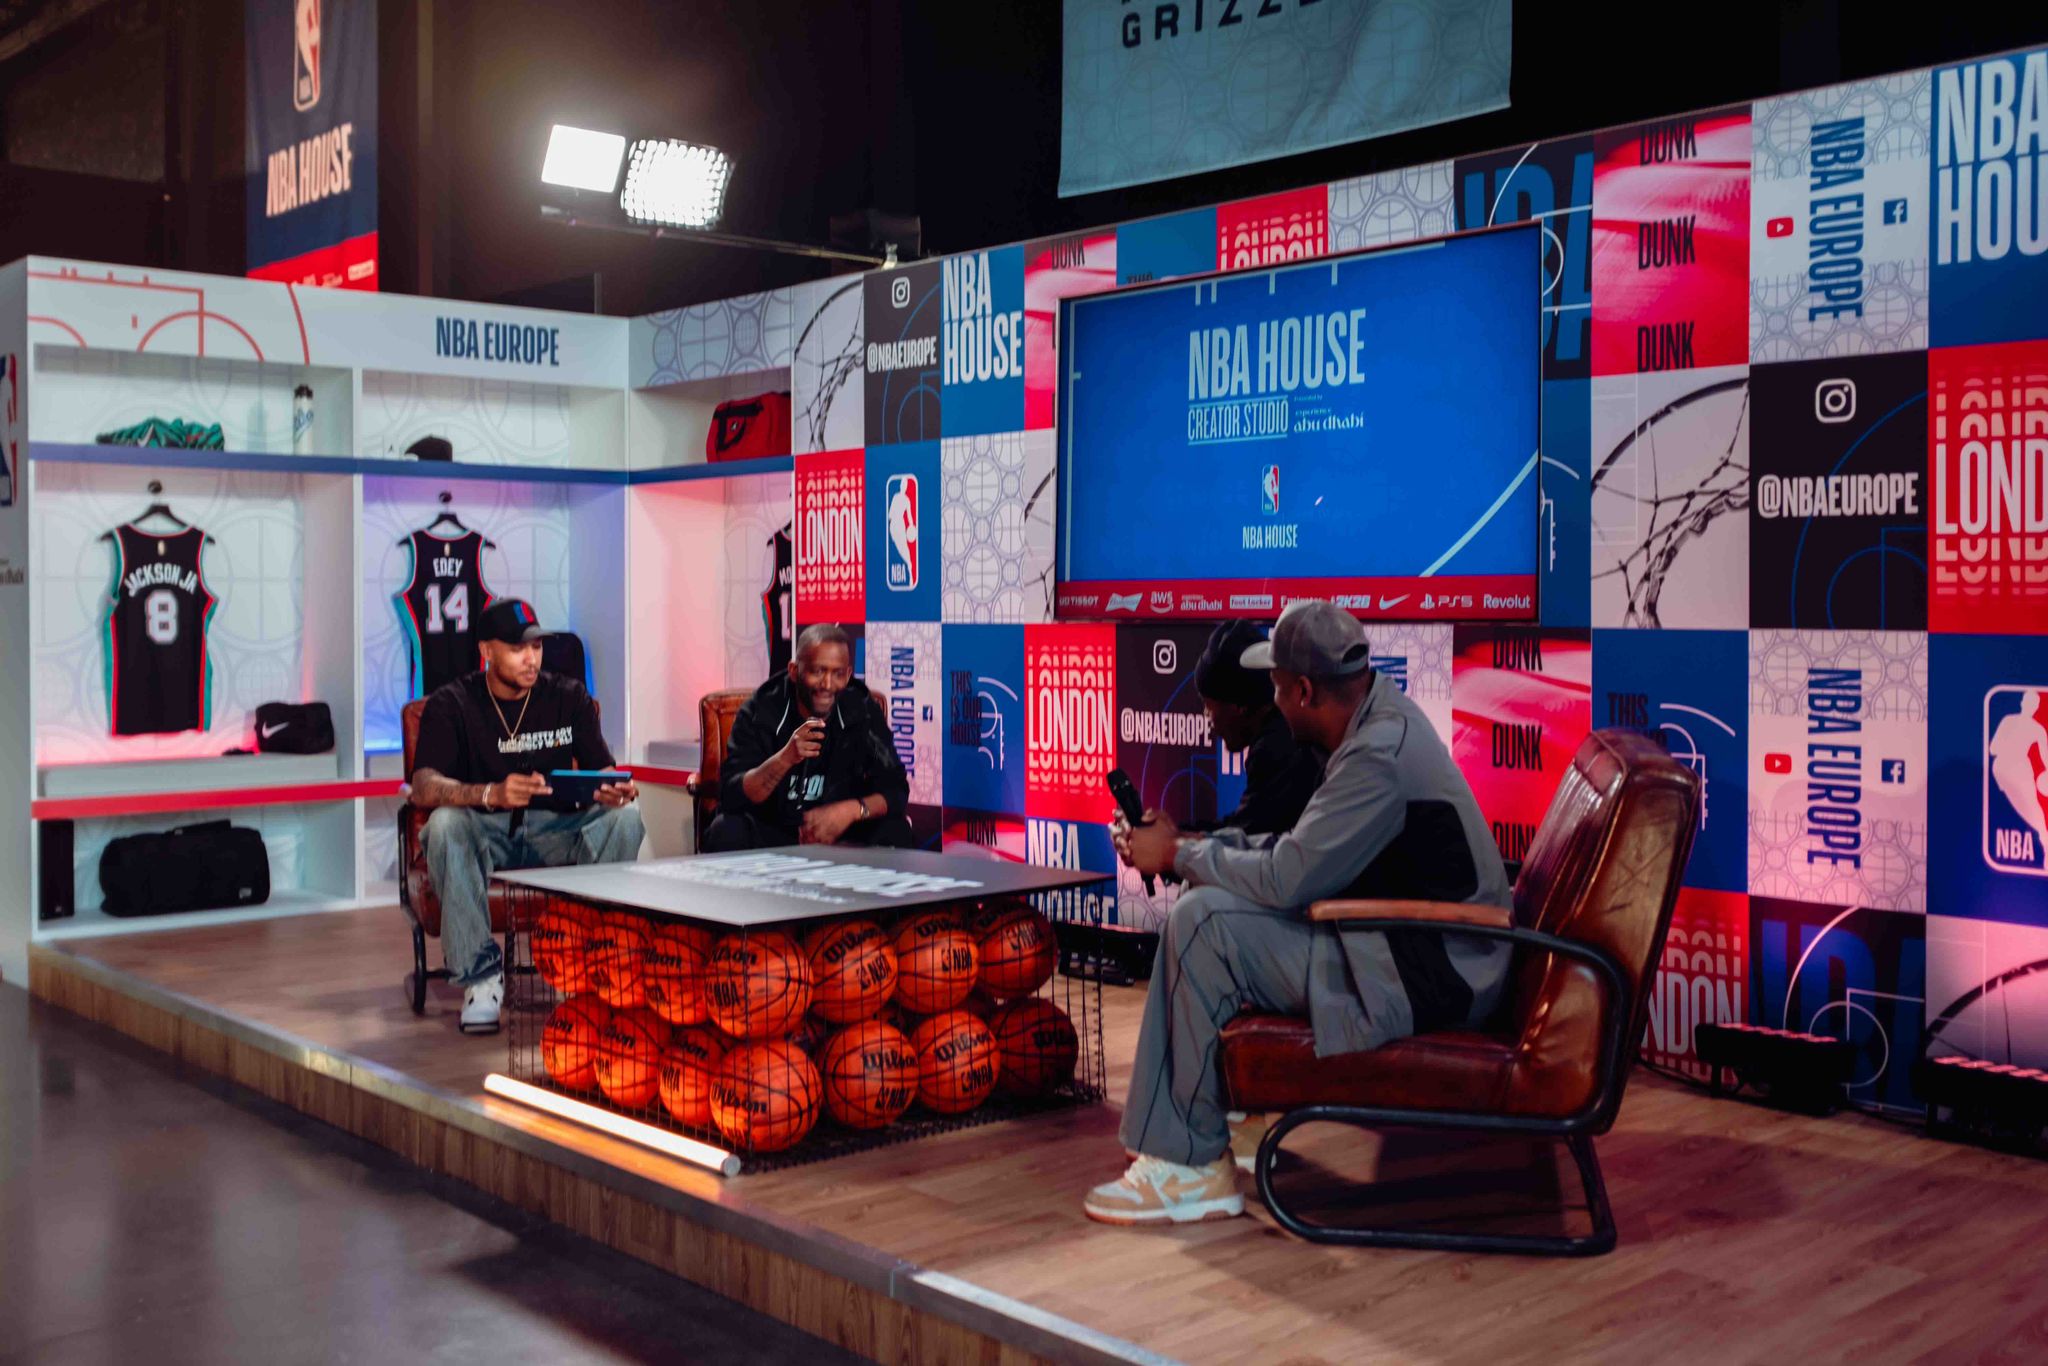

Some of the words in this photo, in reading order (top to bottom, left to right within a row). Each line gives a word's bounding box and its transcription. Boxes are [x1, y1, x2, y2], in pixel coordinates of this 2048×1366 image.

[1122, 0, 1322, 48] GRIZZ
[1938, 51, 2048, 168] NBA
[1639, 122, 1698, 166] DUNK
[1810, 116, 1865, 193] NBA
[266, 146, 298, 218] NBA
[299, 122, 352, 204] HOUSE
[1638, 215, 1696, 271] DUNK
[1809, 193, 1864, 322] EUROPE
[943, 251, 992, 322] NBA
[436, 316, 479, 359] NBA
[484, 321, 559, 366] EUROPE
[867, 336, 937, 373] @NBAEUROPE
[943, 311, 1022, 386] HOUSE
[1188, 324, 1251, 401] NBA
[1258, 308, 1366, 392] HOUSE
[1637, 320, 1694, 373] DUNK
[1188, 404, 1240, 440] CREATOR
[1243, 399, 1289, 437] STUDIO
[1294, 417, 1320, 433] abu
[1323, 411, 1364, 431] dhabi
[1757, 472, 1918, 519] @NBAEUROPE
[798, 505, 862, 566] LONDON
[1242, 525, 1263, 549] NBA
[1264, 524, 1298, 549] HOUSE
[433, 557, 463, 578] EDEY
[891, 563, 906, 583] NBA
[145, 589, 179, 645] 8
[425, 583, 469, 633] 14
[1438, 595, 1473, 607] PS5
[1483, 593, 1531, 609] Revolut
[891, 647, 915, 691] NBA
[1028, 687, 1113, 755] LONDON
[1607, 692, 1649, 725] THIS
[1807, 668, 1862, 734] NBA
[1121, 707, 1213, 747] @NBAEUROPE
[1492, 722, 1543, 772] DUNK
[1807, 743, 1862, 870] EUROPE
[1493, 821, 1536, 861] DUN
[1996, 828, 2035, 861] NBA
[953, 947, 973, 972] NBA
[1641, 973, 1741, 1055] NDON
